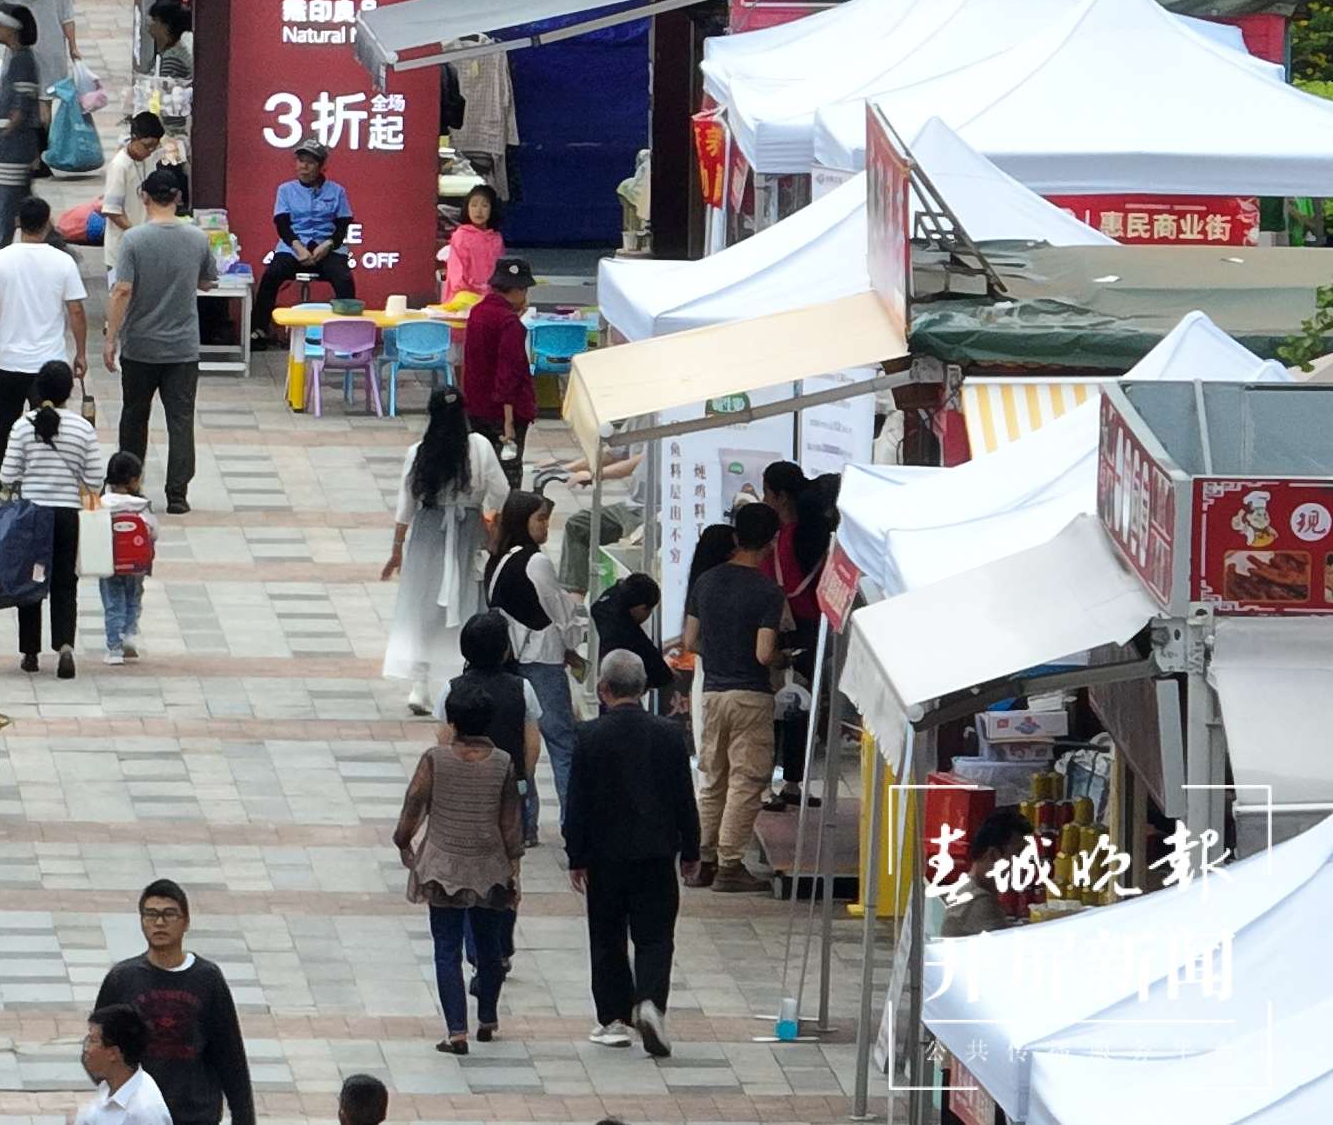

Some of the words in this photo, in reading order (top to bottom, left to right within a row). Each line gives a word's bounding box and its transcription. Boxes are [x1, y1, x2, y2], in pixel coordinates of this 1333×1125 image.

[282, 25, 346, 43] Natural
[370, 94, 406, 112] 全场
[367, 114, 405, 150] 起
[1100, 211, 1232, 241] 惠民商业街
[362, 252, 400, 268] OFF
[1297, 510, 1327, 534] 现
